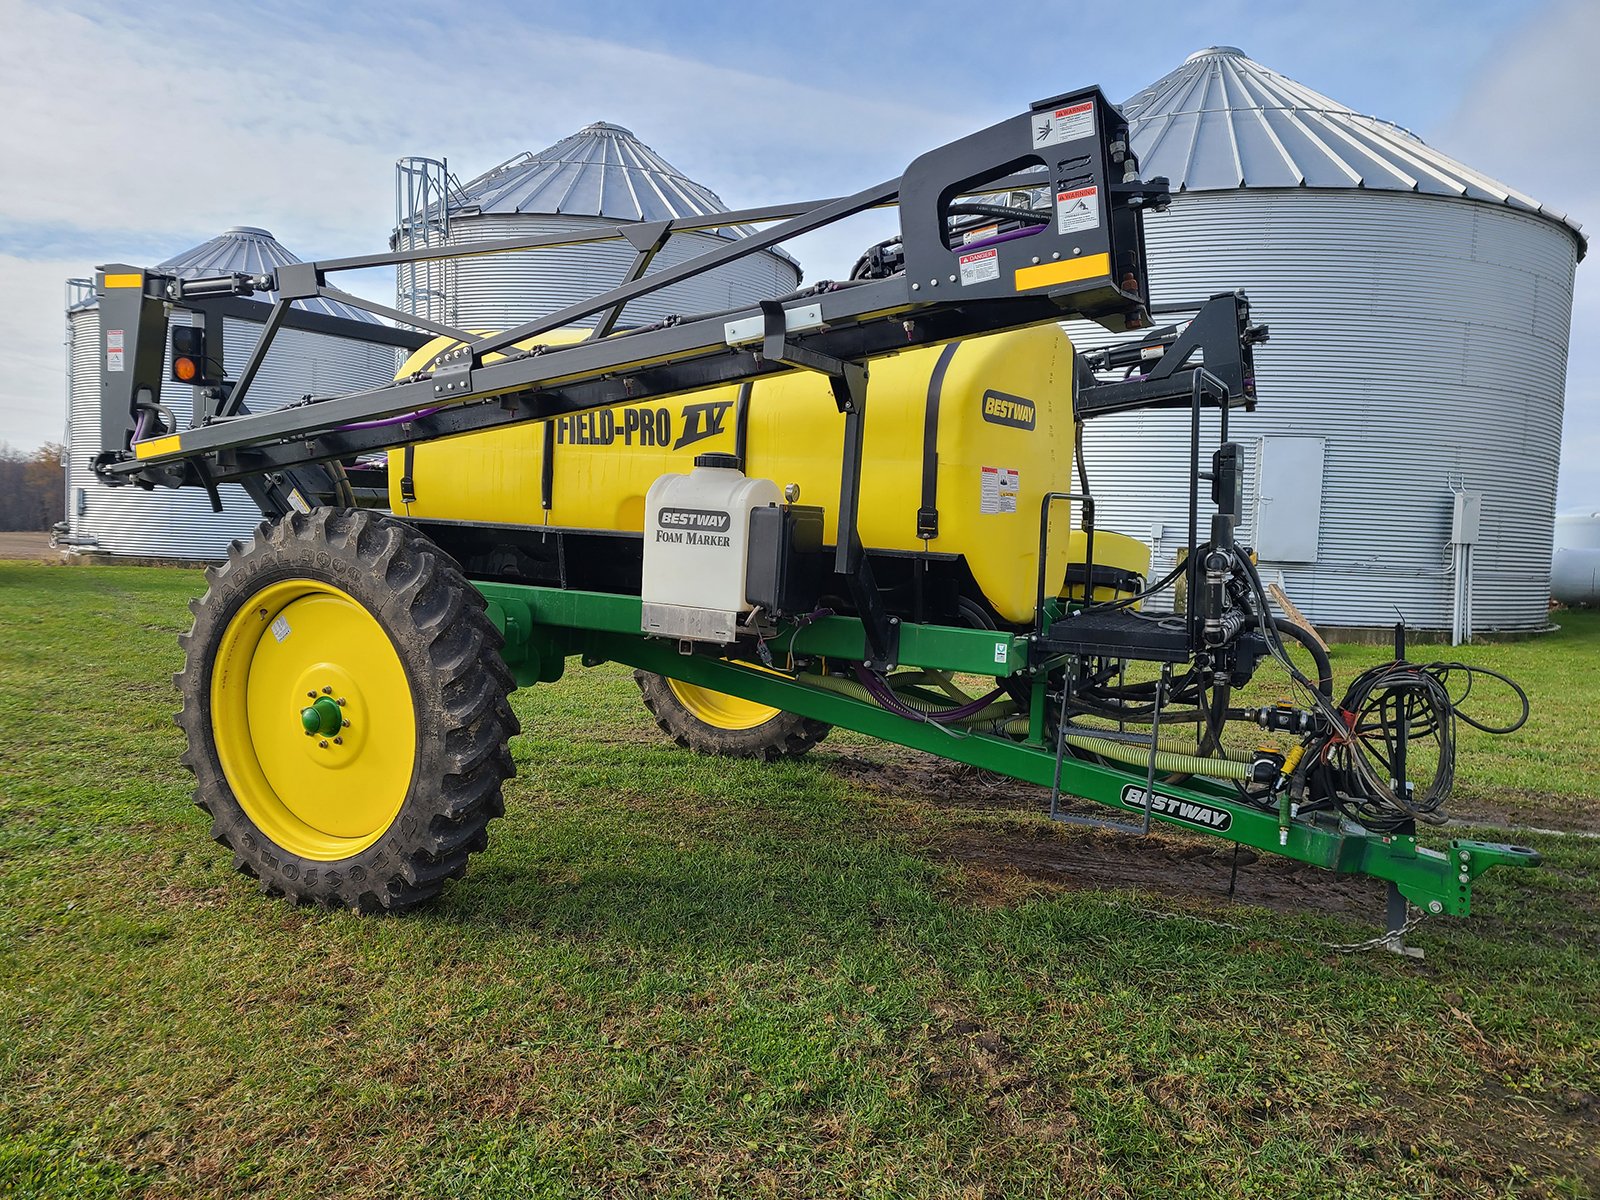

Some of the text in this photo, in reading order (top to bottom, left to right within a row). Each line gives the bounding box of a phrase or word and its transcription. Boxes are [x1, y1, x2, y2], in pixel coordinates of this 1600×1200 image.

[1062, 103, 1093, 116] WARNING
[1065, 187, 1097, 200] WARNING
[969, 251, 993, 262] DANGER
[985, 397, 1034, 423] BESTWAY
[557, 401, 734, 451] FIELD-PRO IV
[661, 512, 728, 527] BESTWAY
[656, 530, 730, 547] FOAM MARKER
